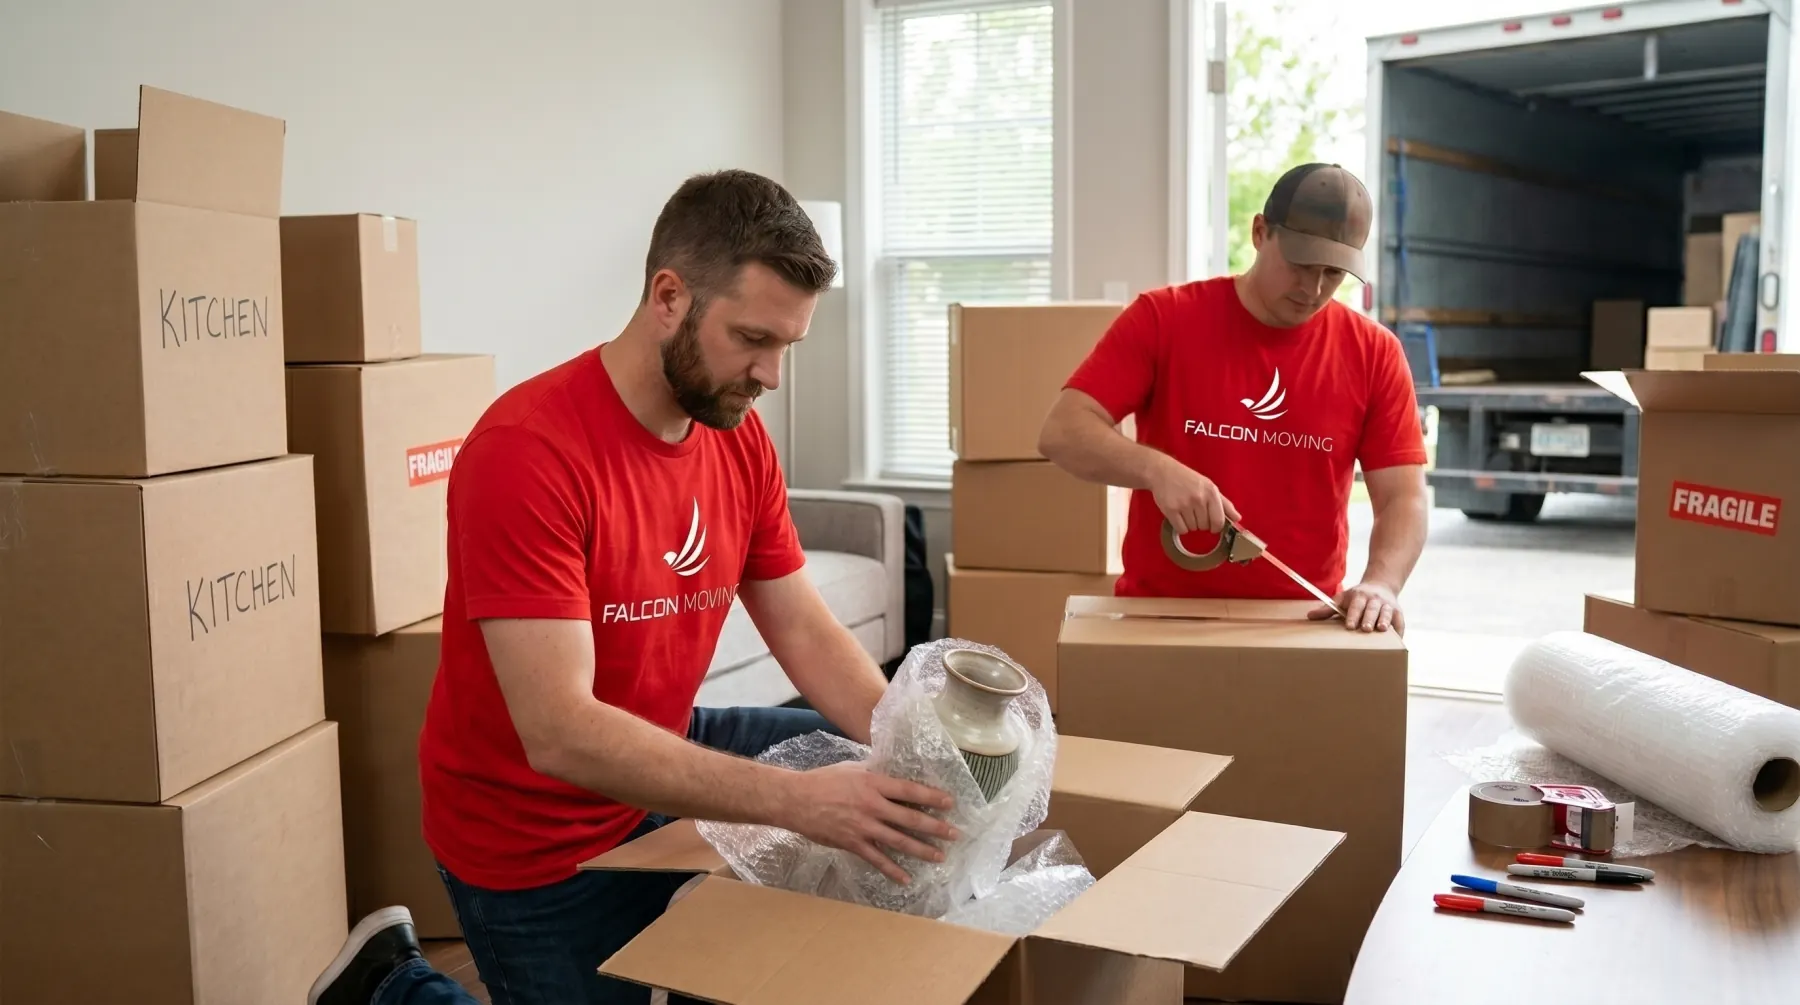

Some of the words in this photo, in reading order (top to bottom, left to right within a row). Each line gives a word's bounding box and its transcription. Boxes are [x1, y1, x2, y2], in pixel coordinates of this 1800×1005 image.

[160, 288, 268, 349] KITCHEN
[1184, 419, 1258, 443] FALCON
[1263, 430, 1333, 452] MOVING
[408, 445, 461, 479] FRAGIL
[1673, 487, 1777, 529] FRAGILE
[187, 553, 295, 641] KITCHEN
[602, 595, 679, 624] FALCON
